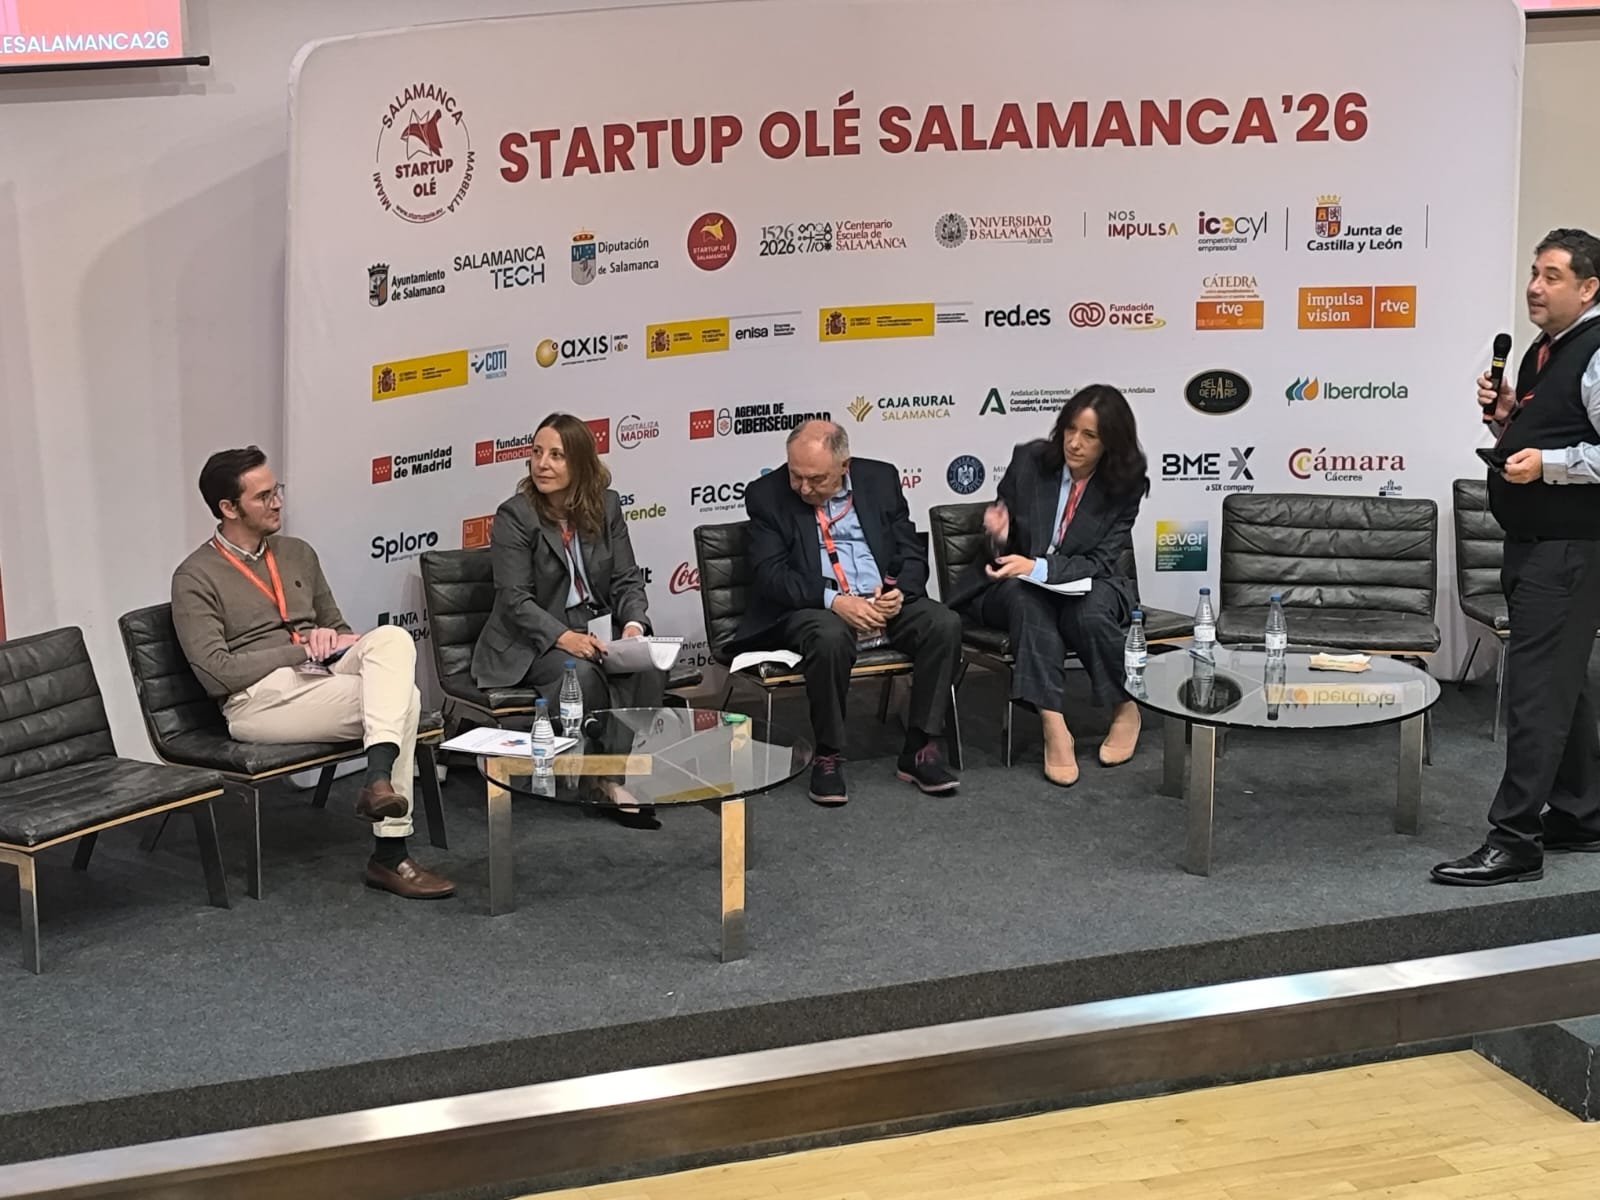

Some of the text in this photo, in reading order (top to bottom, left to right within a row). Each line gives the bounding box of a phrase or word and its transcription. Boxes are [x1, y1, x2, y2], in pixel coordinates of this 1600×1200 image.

[0, 31, 169, 53] ESALAMANCA26
[382, 83, 463, 128] SALAMANCA
[500, 115, 743, 183] STARTUP
[759, 90, 861, 159] OLÉ
[395, 158, 454, 179] STARTUP
[413, 177, 437, 197] OLÉ
[447, 151, 475, 213] MARBELLA
[373, 172, 392, 211] MIAMI
[970, 215, 1052, 228] VNIVERSIDAD
[1108, 210, 1136, 221] NOS
[761, 223, 794, 240] 1526
[836, 219, 893, 230] V Centenario
[1344, 224, 1403, 236] Junta de
[836, 230, 882, 240] Escuela de
[979, 227, 1053, 240] SALAMANCA
[1198, 237, 1247, 245] competitividad
[598, 237, 649, 254] Diputación
[693, 246, 719, 254] STARTUP
[760, 239, 796, 256] 2026
[836, 237, 907, 251] SALAMANCA
[1307, 238, 1402, 253] Castilla y León
[454, 245, 546, 271] SALAMANCA
[598, 260, 659, 275] de Salamanca
[391, 269, 446, 287] Ayuntamiento
[490, 263, 545, 290] TECH
[1203, 273, 1258, 288] CÁTEDRA
[391, 283, 446, 302] de Salamanca
[1109, 303, 1154, 312] Fundación
[1307, 293, 1363, 309] impulsa
[1380, 300, 1410, 314] rtve
[985, 304, 1051, 327] red.es
[1216, 303, 1244, 317] rtve
[1307, 309, 1351, 322] vision
[1109, 313, 1154, 325] ONCE
[735, 327, 769, 340] enisa
[561, 335, 608, 359] axis
[485, 350, 507, 372] CDTI
[1323, 381, 1409, 399] Iberdrola
[877, 395, 956, 409] CAJA RURAL
[735, 403, 784, 418] AGENCIA DE
[882, 409, 950, 421] SALAMANCA
[621, 421, 659, 432] DIGITALIZA
[496, 433, 533, 449] fundació
[621, 428, 659, 442] MADRID
[394, 446, 452, 465] Comunidad
[1288, 448, 1405, 479] Cámara
[394, 458, 452, 479] de Madrid
[1162, 453, 1220, 475] BME
[902, 475, 921, 489] AP
[1325, 471, 1363, 481] Cáceres
[691, 482, 745, 506] Facs
[1223, 484, 1254, 492] company
[624, 504, 667, 521] rende
[371, 531, 439, 563] Sploro
